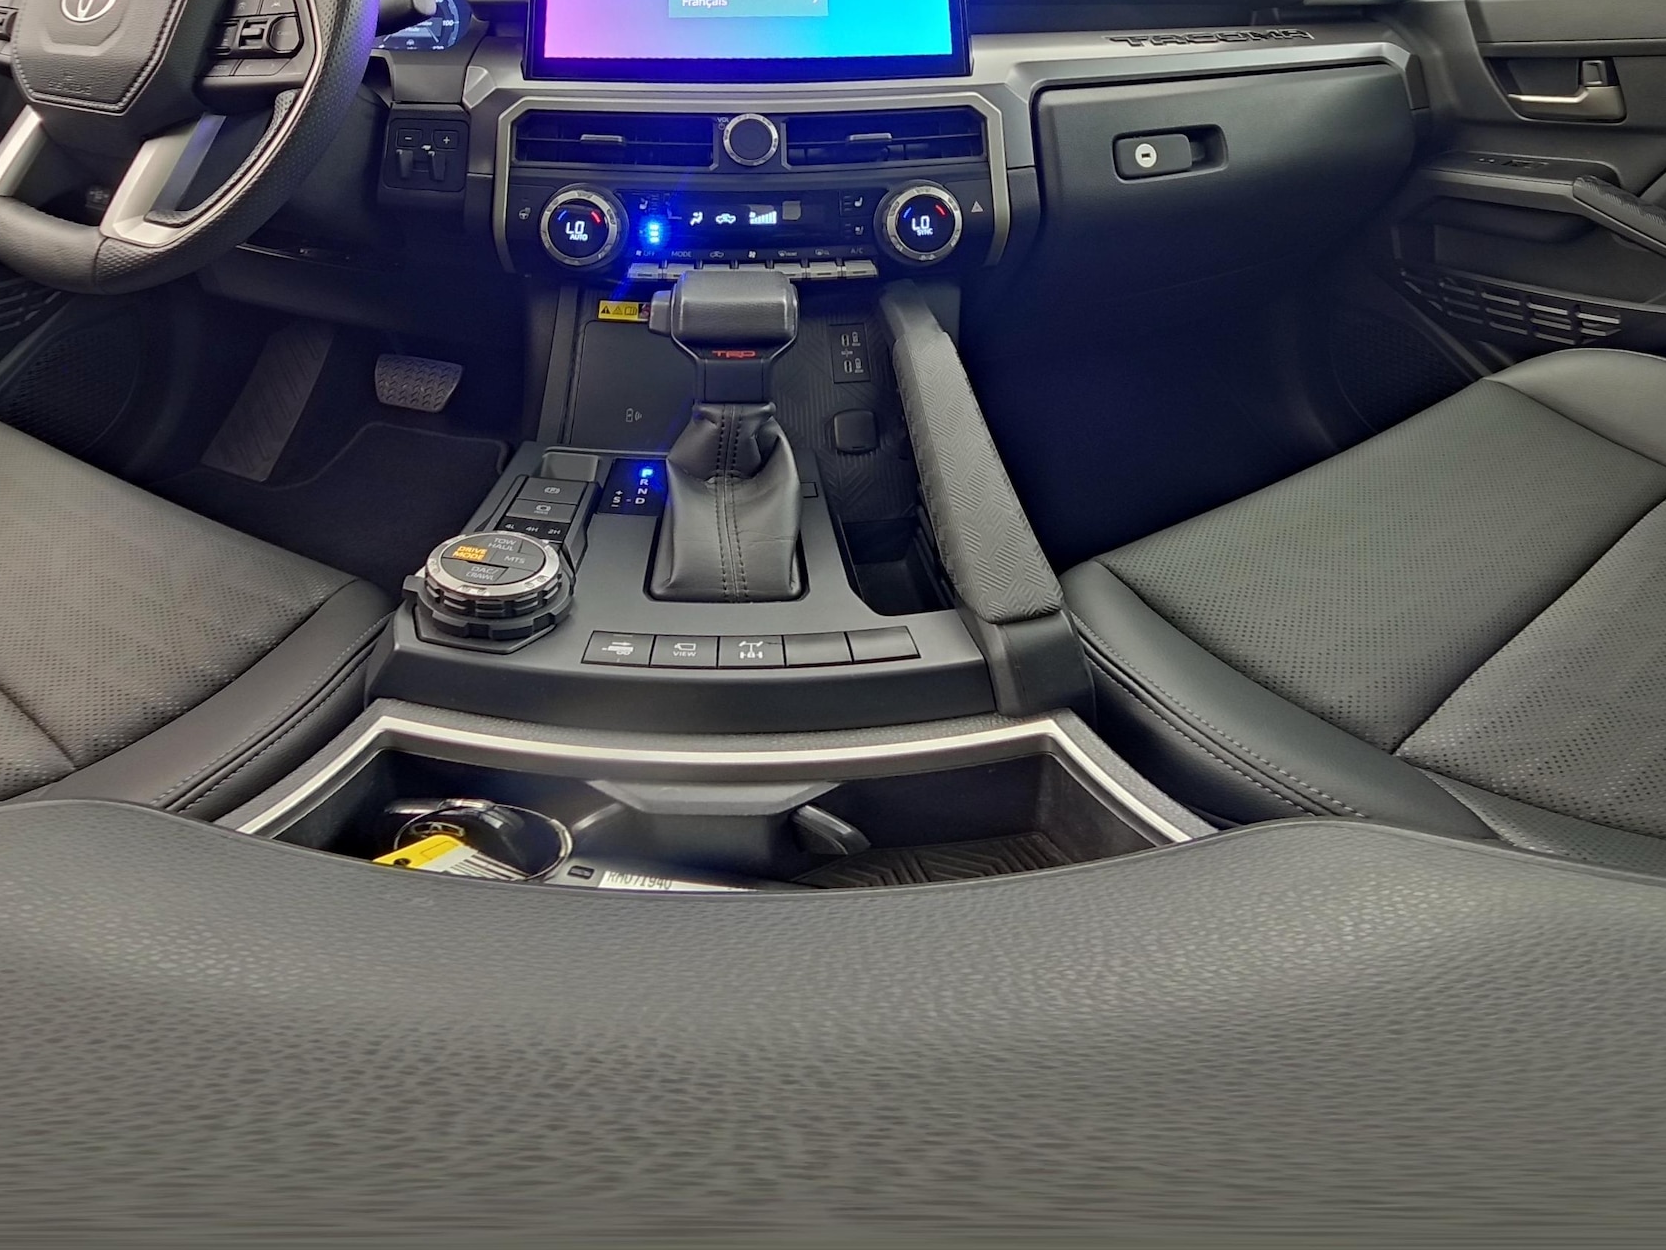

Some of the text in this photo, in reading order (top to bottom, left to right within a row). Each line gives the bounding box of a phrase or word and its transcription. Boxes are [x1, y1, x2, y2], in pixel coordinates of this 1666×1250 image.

[442, 19, 454, 27] 100
[1104, 28, 1316, 48] TACOMA
[565, 220, 586, 235] LO
[911, 215, 931, 232] LO
[569, 233, 588, 241] AUTO
[916, 228, 934, 237] SYNC
[712, 349, 756, 358] TRD
[641, 468, 654, 478] P
[639, 478, 649, 486] R
[612, 496, 646, 505] S D
[526, 525, 539, 533] 4H
[492, 536, 517, 546] TOW
[457, 545, 487, 555] DRIVE
[487, 541, 515, 552] HAUL
[452, 551, 484, 561] MODE
[504, 555, 526, 565] MTS
[470, 565, 497, 574] DAC/
[465, 570, 496, 582] CRAWL
